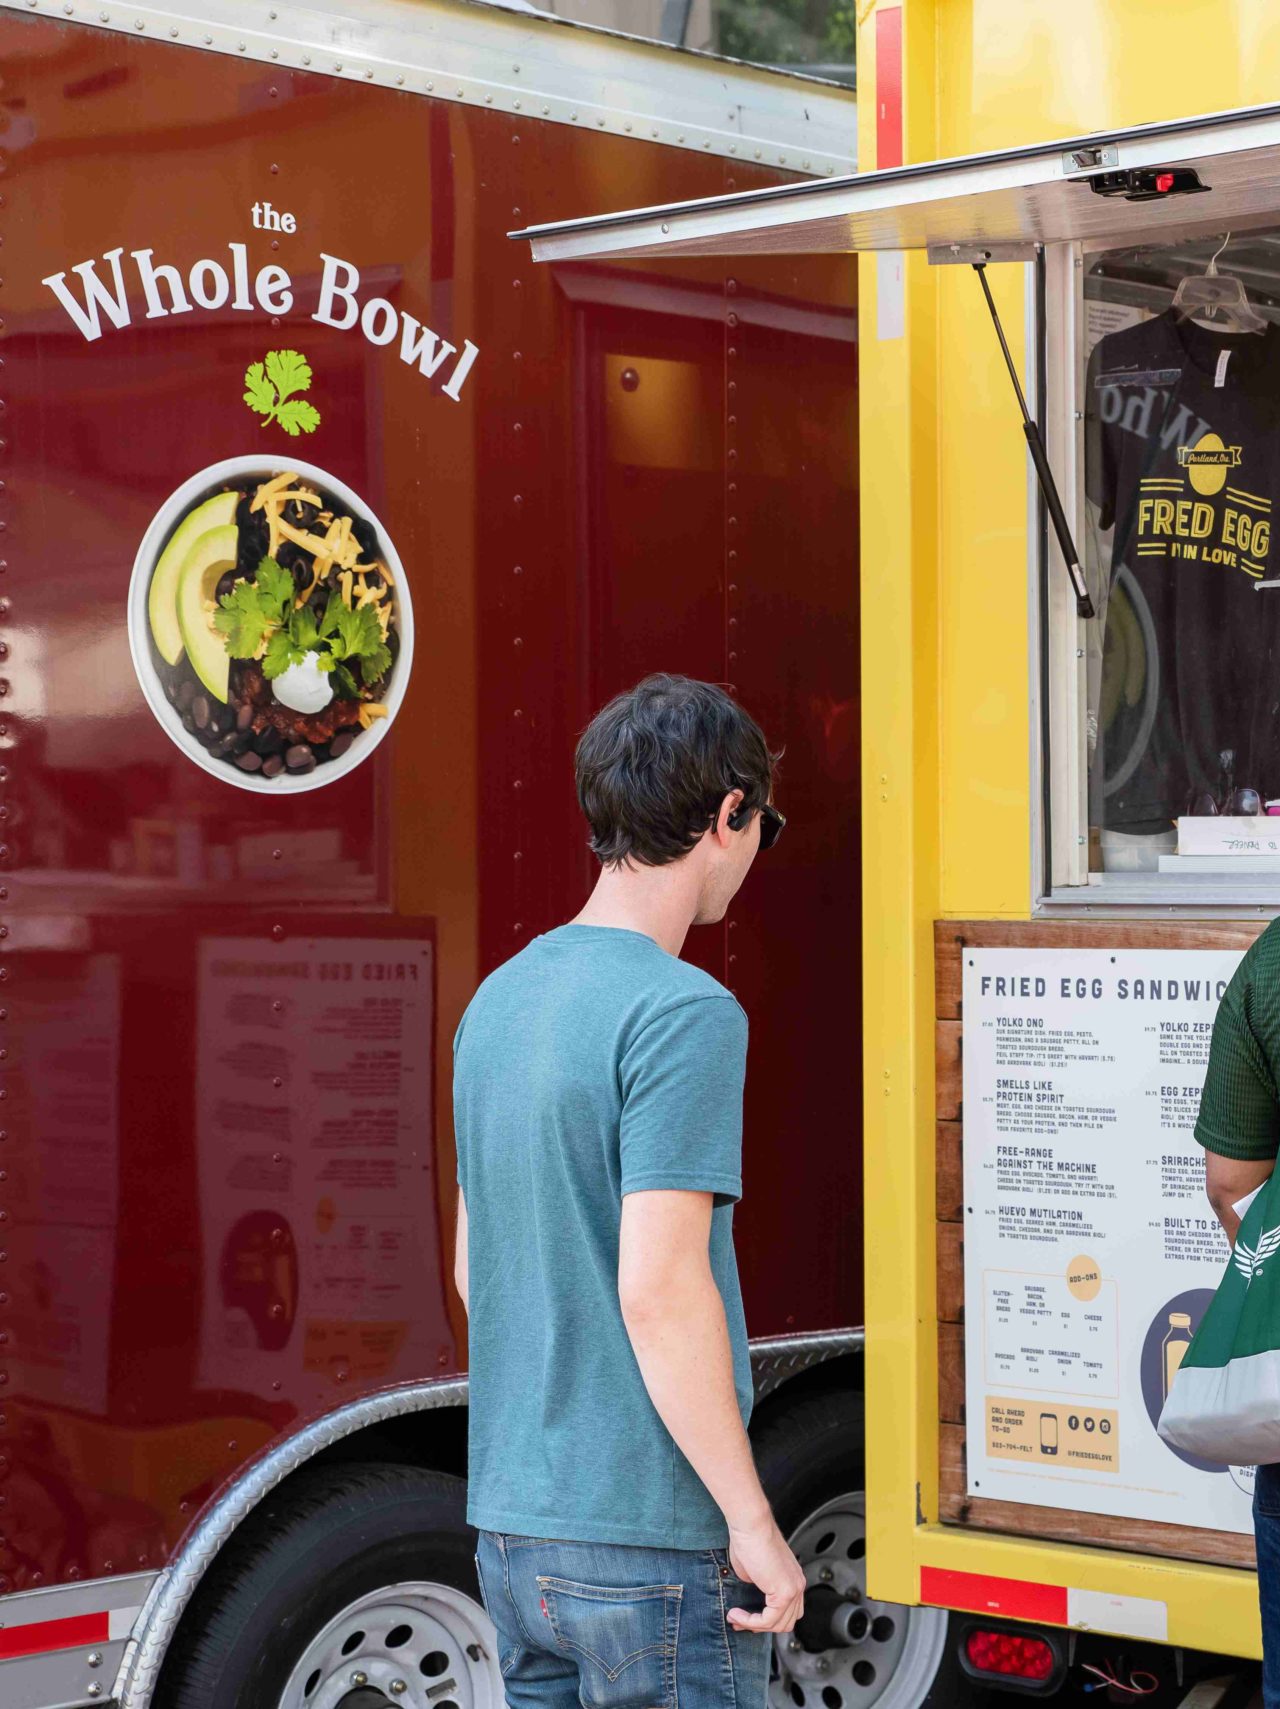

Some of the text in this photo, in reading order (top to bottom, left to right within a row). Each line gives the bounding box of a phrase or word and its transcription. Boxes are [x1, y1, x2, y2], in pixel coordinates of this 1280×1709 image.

[251, 202, 296, 234] the
[42, 242, 479, 402] Whole Bowl
[1222, 508, 1271, 558] EGG
[1183, 543, 1198, 560] IN
[1202, 546, 1237, 568] LOVE
[981, 976, 1228, 1001] FRIED EGG SANDWIC
[996, 1017, 1044, 1028] YOLKO ONO
[1159, 1022, 1189, 1032] YOLKO
[996, 1079, 1053, 1091] SMELLS LIKE
[1160, 1086, 1178, 1096] EGG
[996, 1091, 1064, 1103] PROTEIN SPIRIT
[997, 1145, 1053, 1158] FREE-RANGE
[997, 1157, 1096, 1173] AGAINST THE MACHINE
[998, 1206, 1083, 1221] HUEVO MUTILATION
[1164, 1217, 1192, 1228] BUILT
[1194, 1219, 1207, 1230] TO
[1070, 1273, 1098, 1284] ADD-ONS
